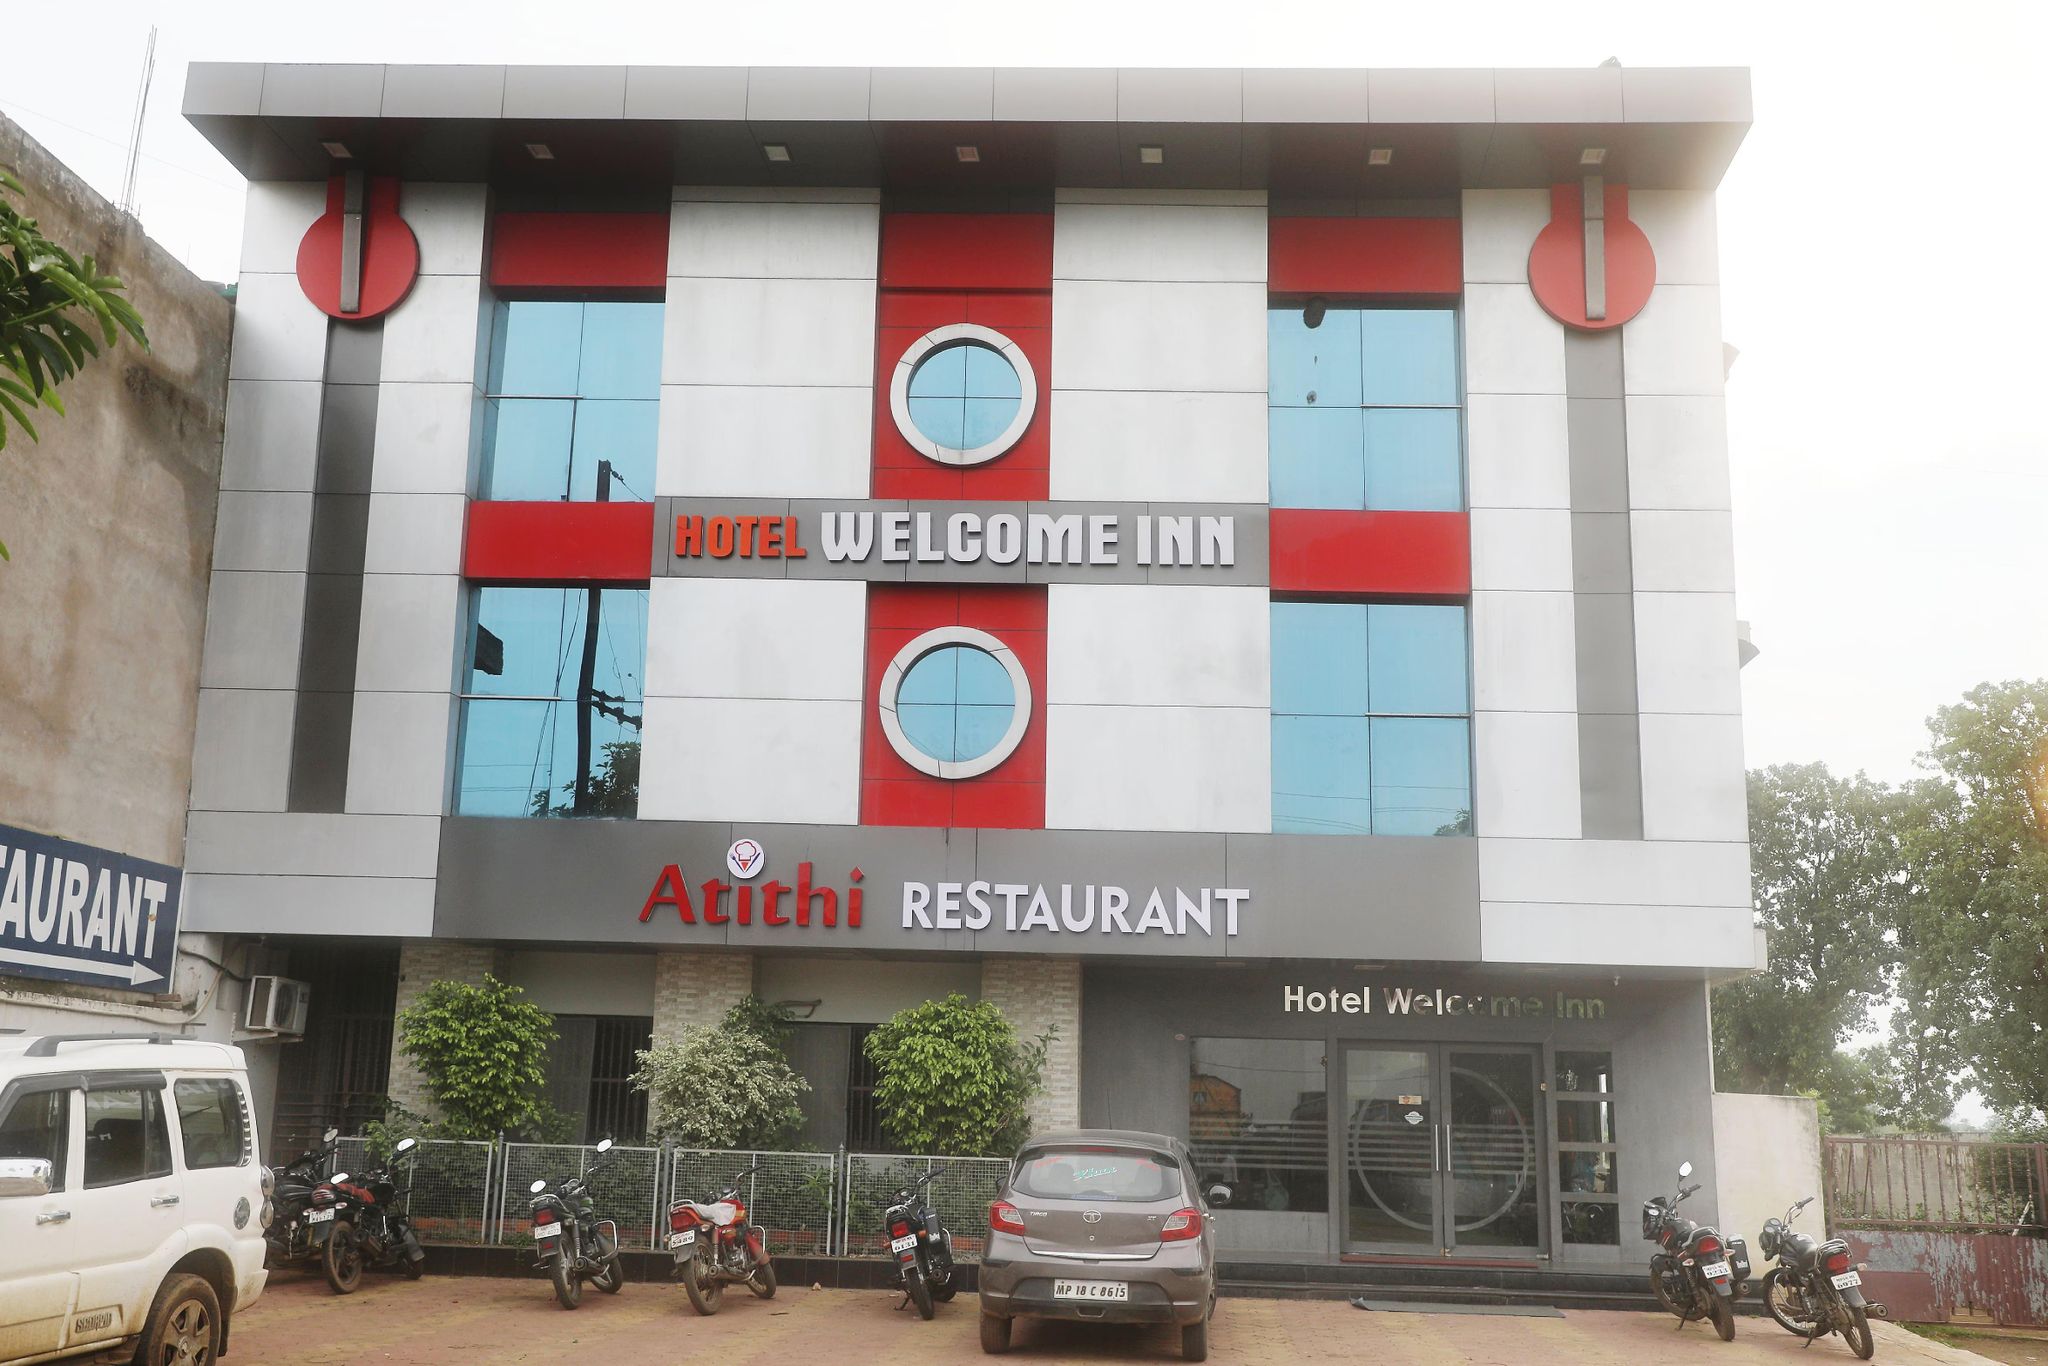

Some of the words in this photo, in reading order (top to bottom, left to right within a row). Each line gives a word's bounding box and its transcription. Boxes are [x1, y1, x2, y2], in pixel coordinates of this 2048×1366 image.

[674, 514, 807, 559] HOTEL
[821, 511, 1118, 565] WELCOME
[1136, 514, 1235, 565] INN
[639, 862, 864, 929] Atithi
[902, 880, 1250, 937] RESTAURANT
[1284, 985, 1370, 1014] Hotel
[1383, 987, 1544, 1016] Welcome
[1556, 990, 1607, 1018] Inn
[1056, 1284, 1072, 1295] MP
[1076, 1285, 1087, 1296] 18
[1090, 1286, 1097, 1296] C
[1100, 1287, 1126, 1298] 8615
